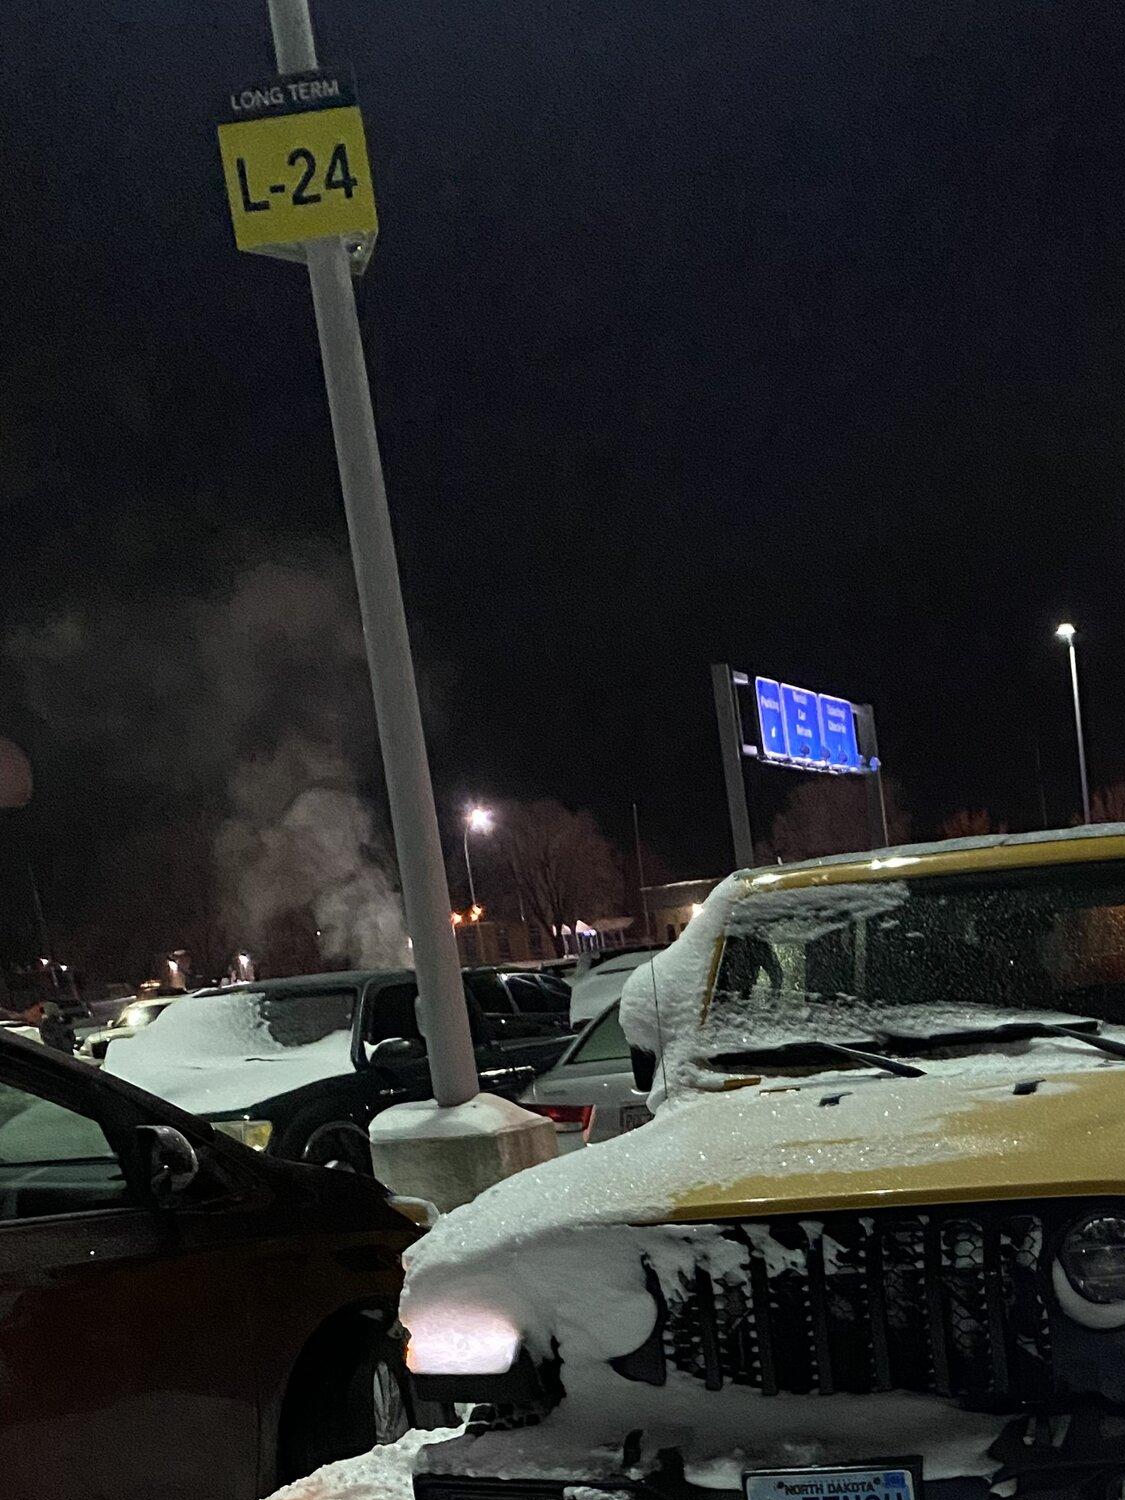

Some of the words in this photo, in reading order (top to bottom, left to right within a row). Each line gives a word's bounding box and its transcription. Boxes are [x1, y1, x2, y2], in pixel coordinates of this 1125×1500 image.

[231, 87, 284, 110] LONG
[287, 79, 340, 101] TERM
[236, 143, 358, 212] L-24
[785, 1483, 824, 1496] NORTH
[828, 1480, 876, 1495] DAKOTA
